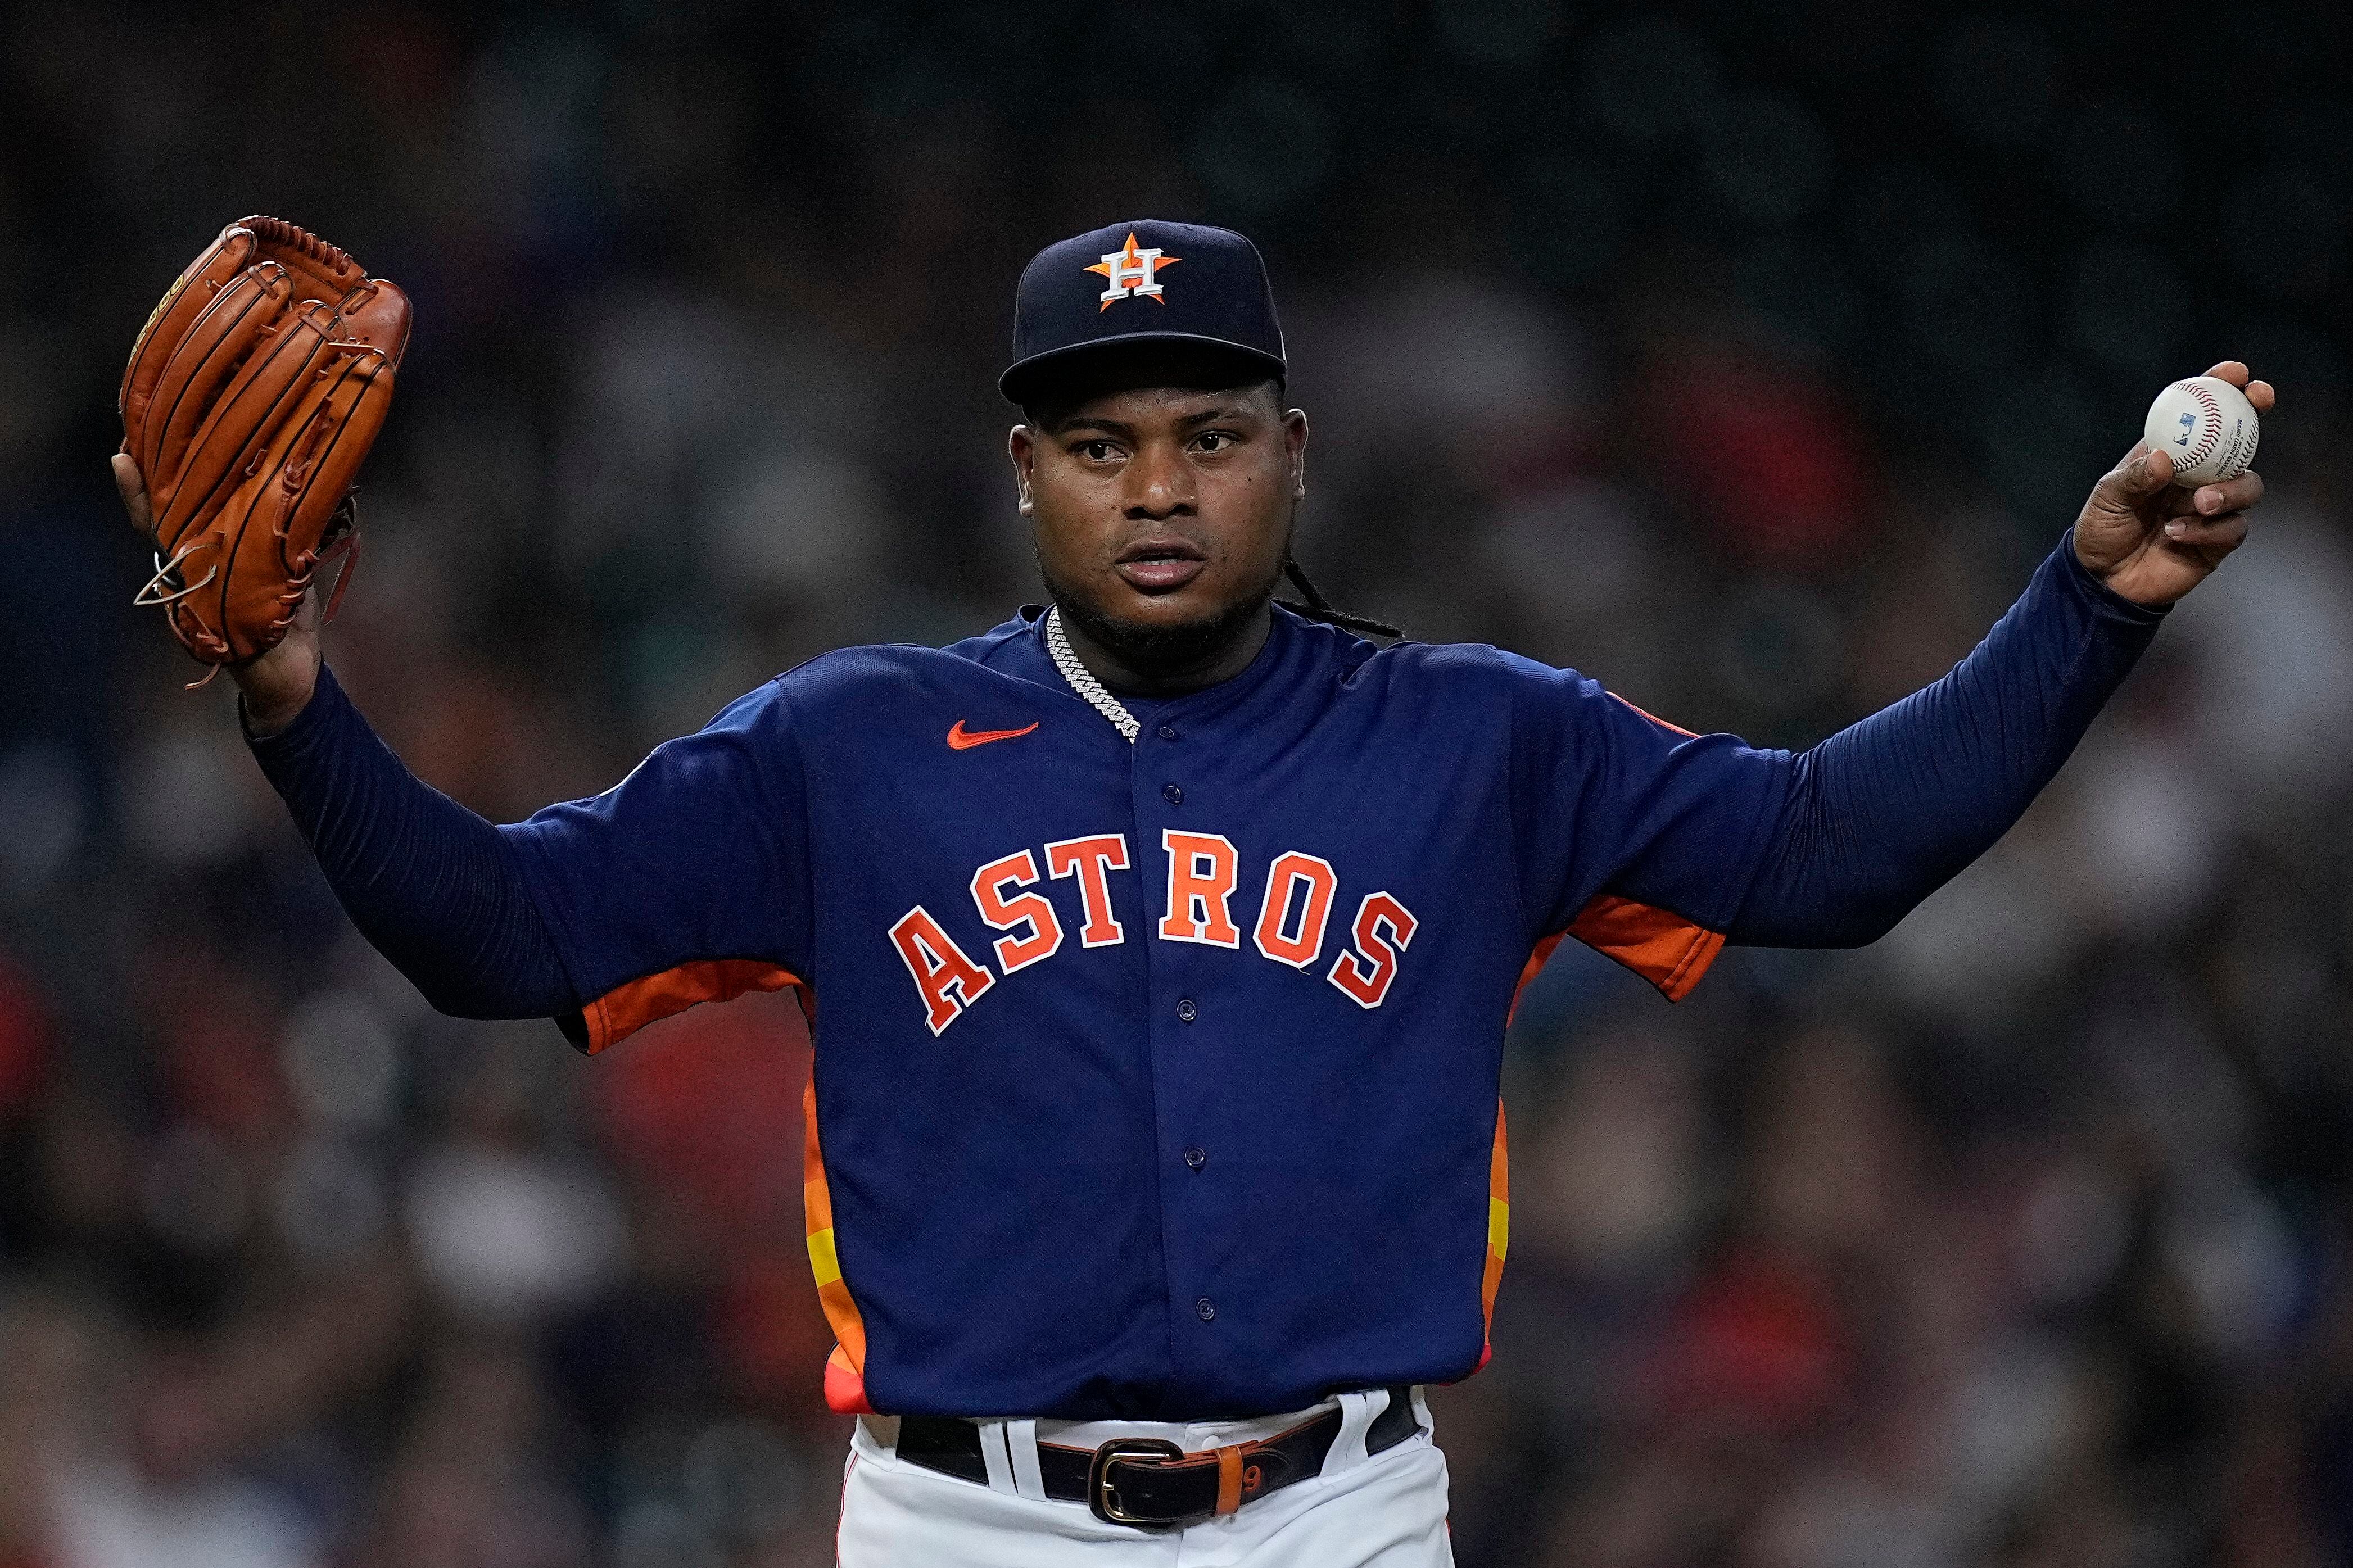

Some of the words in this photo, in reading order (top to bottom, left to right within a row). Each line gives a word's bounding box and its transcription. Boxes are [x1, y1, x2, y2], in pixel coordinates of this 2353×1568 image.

[1101, 248, 1164, 302] H
[2230, 438, 2240, 456] LEAGUE
[888, 828, 1419, 1037] ASTROS
[1243, 1465, 1261, 1493] 9
